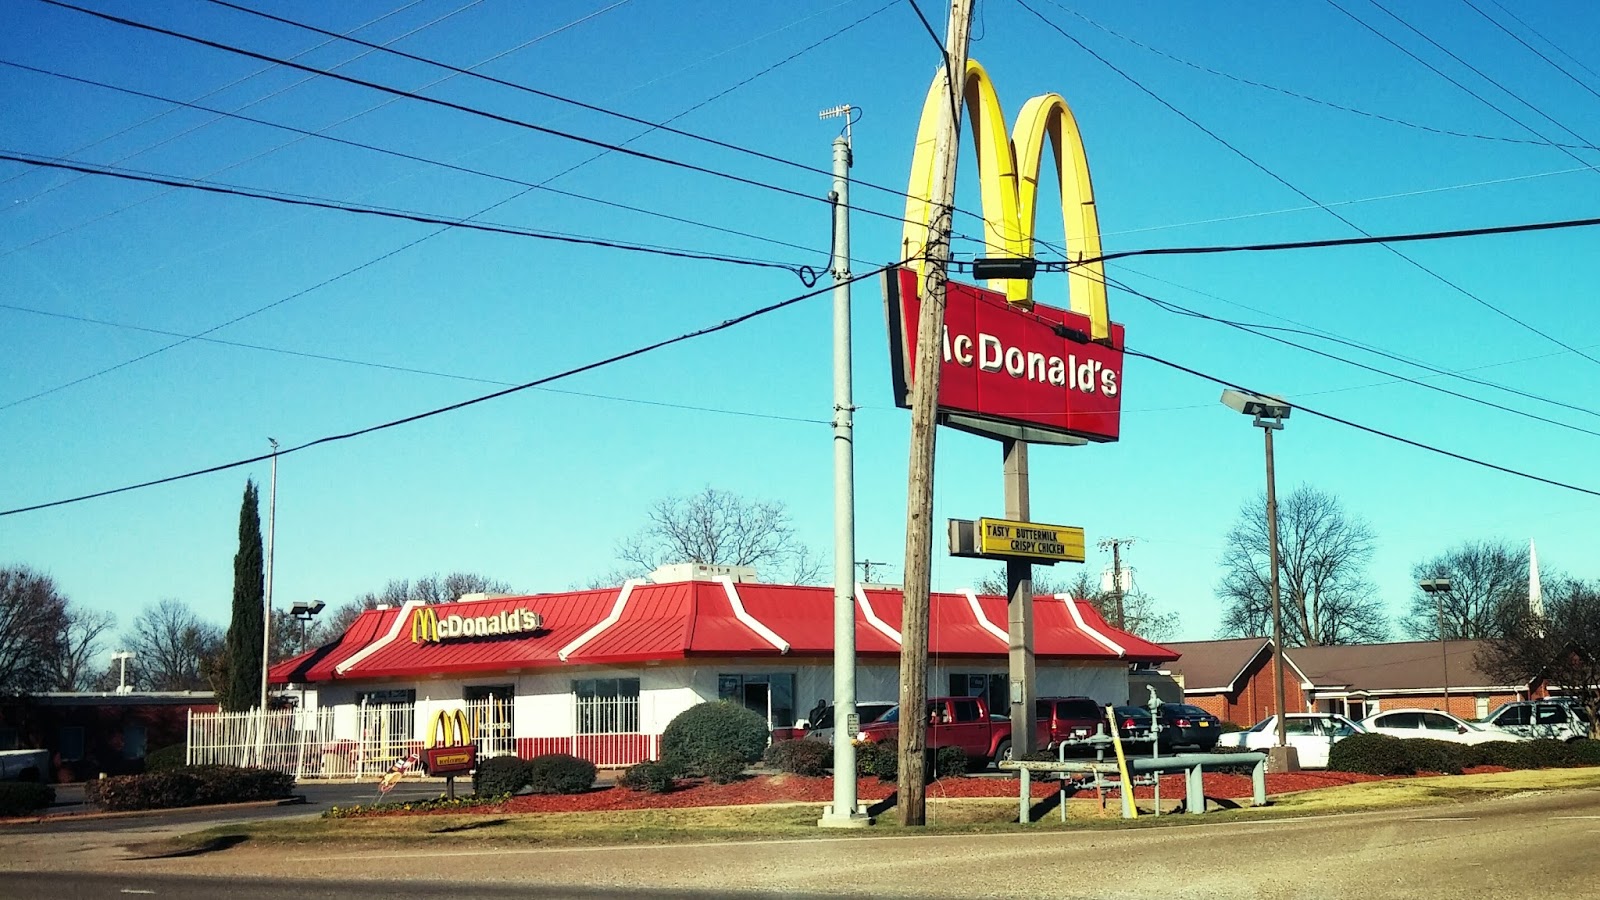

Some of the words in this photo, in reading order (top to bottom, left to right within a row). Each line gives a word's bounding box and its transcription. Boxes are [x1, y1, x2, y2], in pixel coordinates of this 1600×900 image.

[941, 324, 1118, 397] cDonald's
[986, 525, 1010, 537] TASTY
[1016, 528, 1058, 542] BUTTERMILK
[1010, 540, 1035, 553] CRISPY
[1038, 542, 1065, 555] CHICKEN
[412, 607, 537, 644] McDonald's
